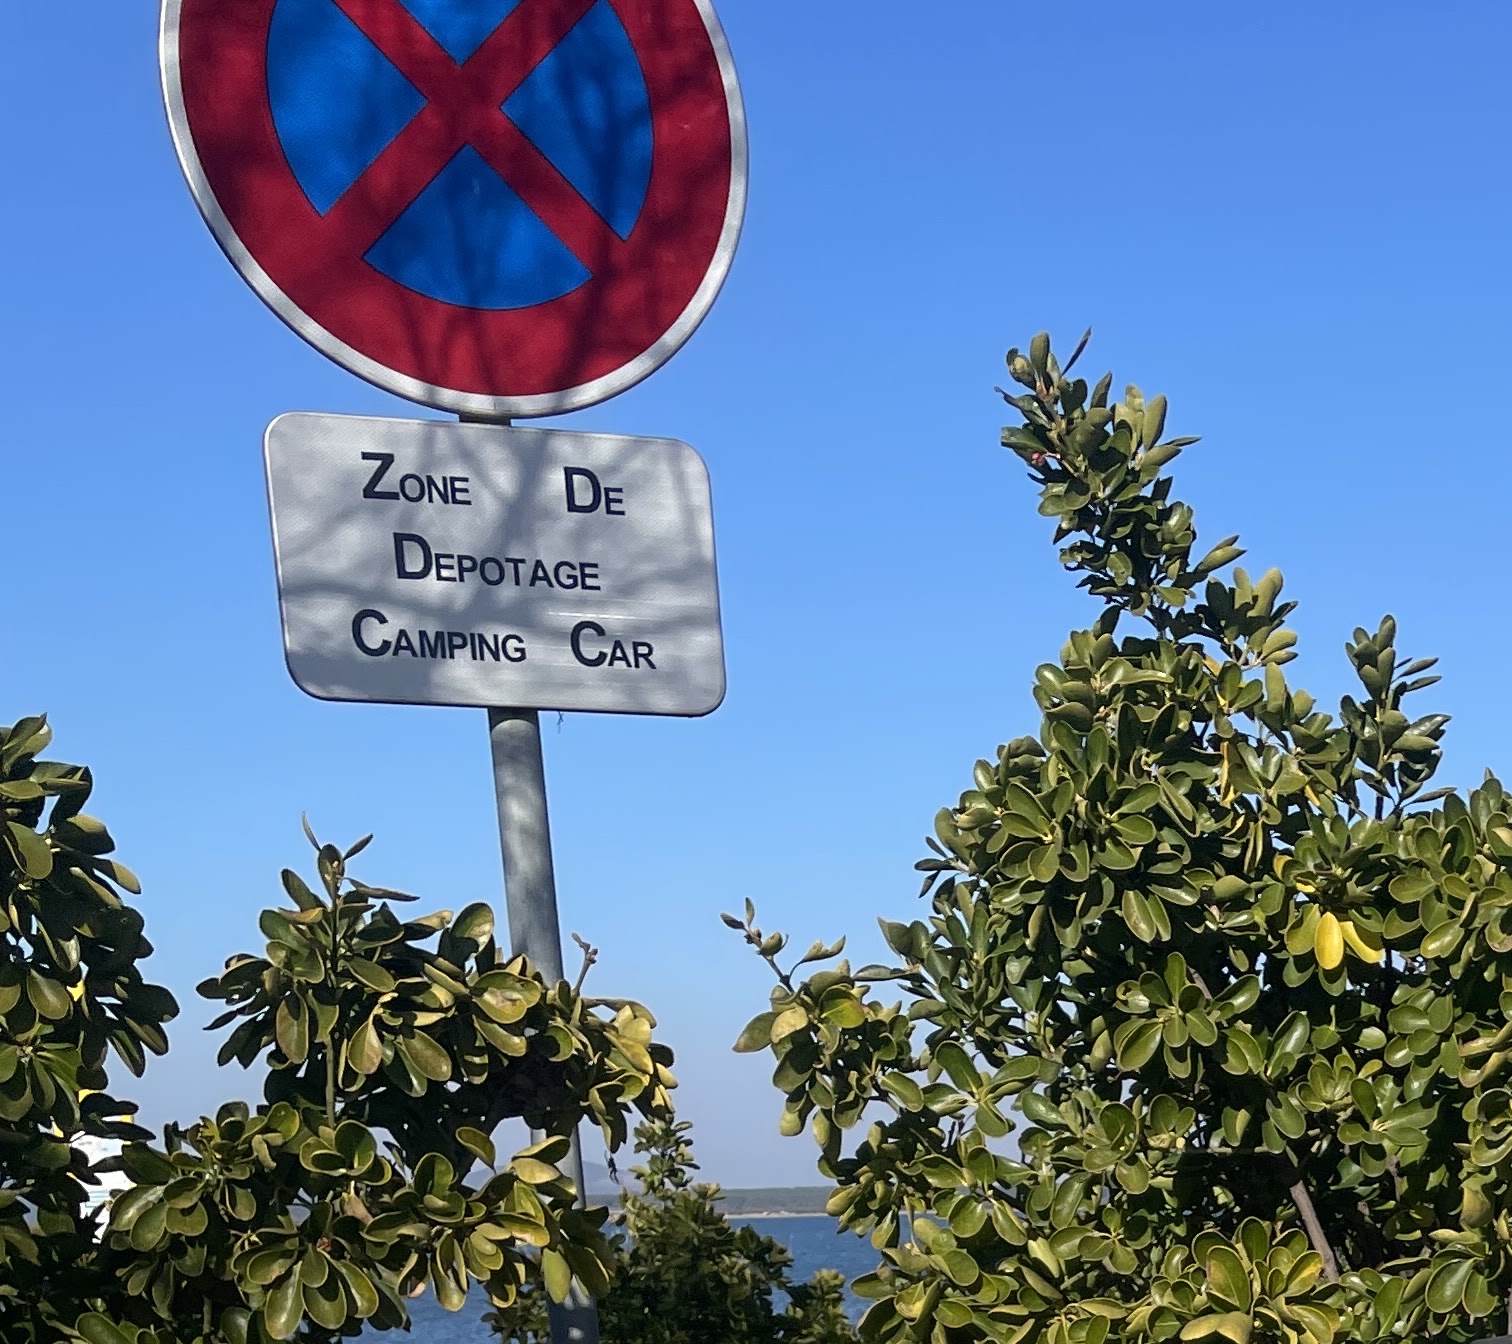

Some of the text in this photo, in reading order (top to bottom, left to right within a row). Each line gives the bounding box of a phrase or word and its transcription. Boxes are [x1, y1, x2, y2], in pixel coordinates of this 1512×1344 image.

[361, 452, 472, 505] ZONE
[393, 532, 601, 591] DEPOTAGE
[351, 609, 656, 670] CAMPING CAR
